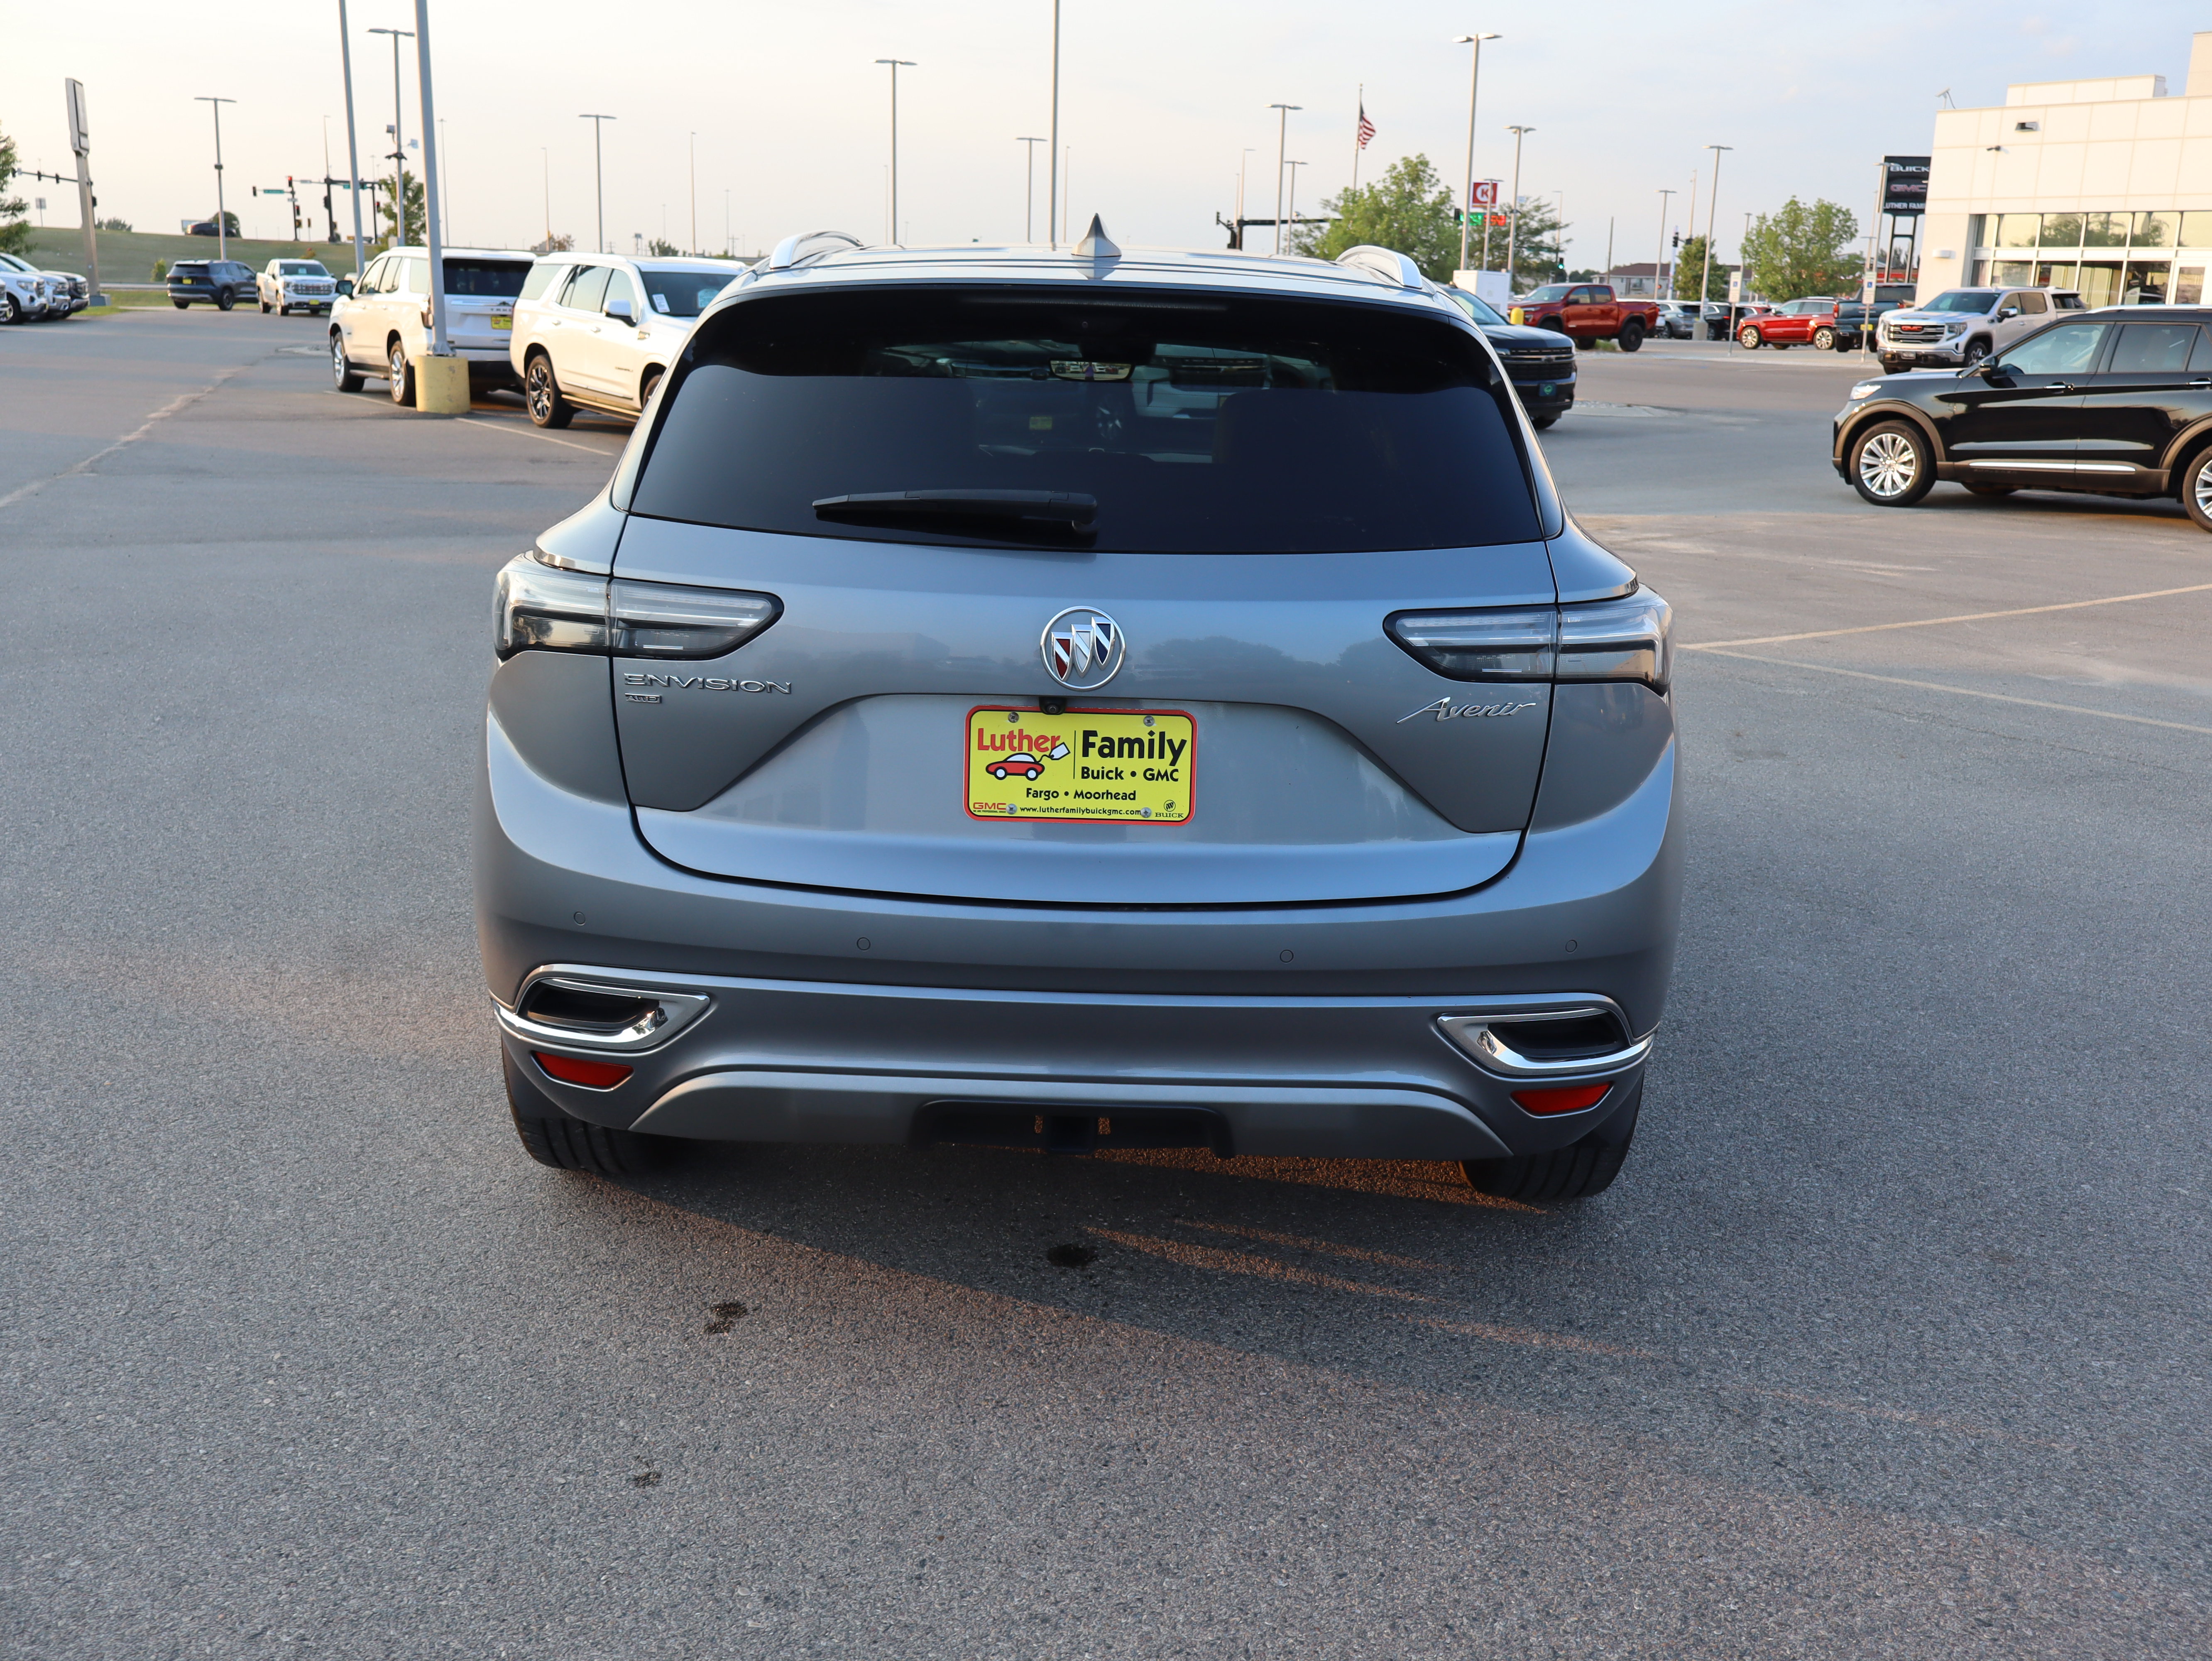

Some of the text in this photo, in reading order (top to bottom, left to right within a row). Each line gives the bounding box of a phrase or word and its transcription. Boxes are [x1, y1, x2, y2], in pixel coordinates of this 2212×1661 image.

[1481, 188, 1489, 198] K
[624, 673, 791, 694] ENVISION
[625, 693, 661, 703] AWD
[1396, 697, 1536, 724] Avenir
[978, 728, 1061, 752] Luther
[1082, 730, 1187, 766] Family
[1081, 766, 1179, 782] Buick GMC
[1026, 788, 1136, 801] Fargo Moorhead
[1020, 806, 1141, 815] www.lutherfamilybuickgmc.com
